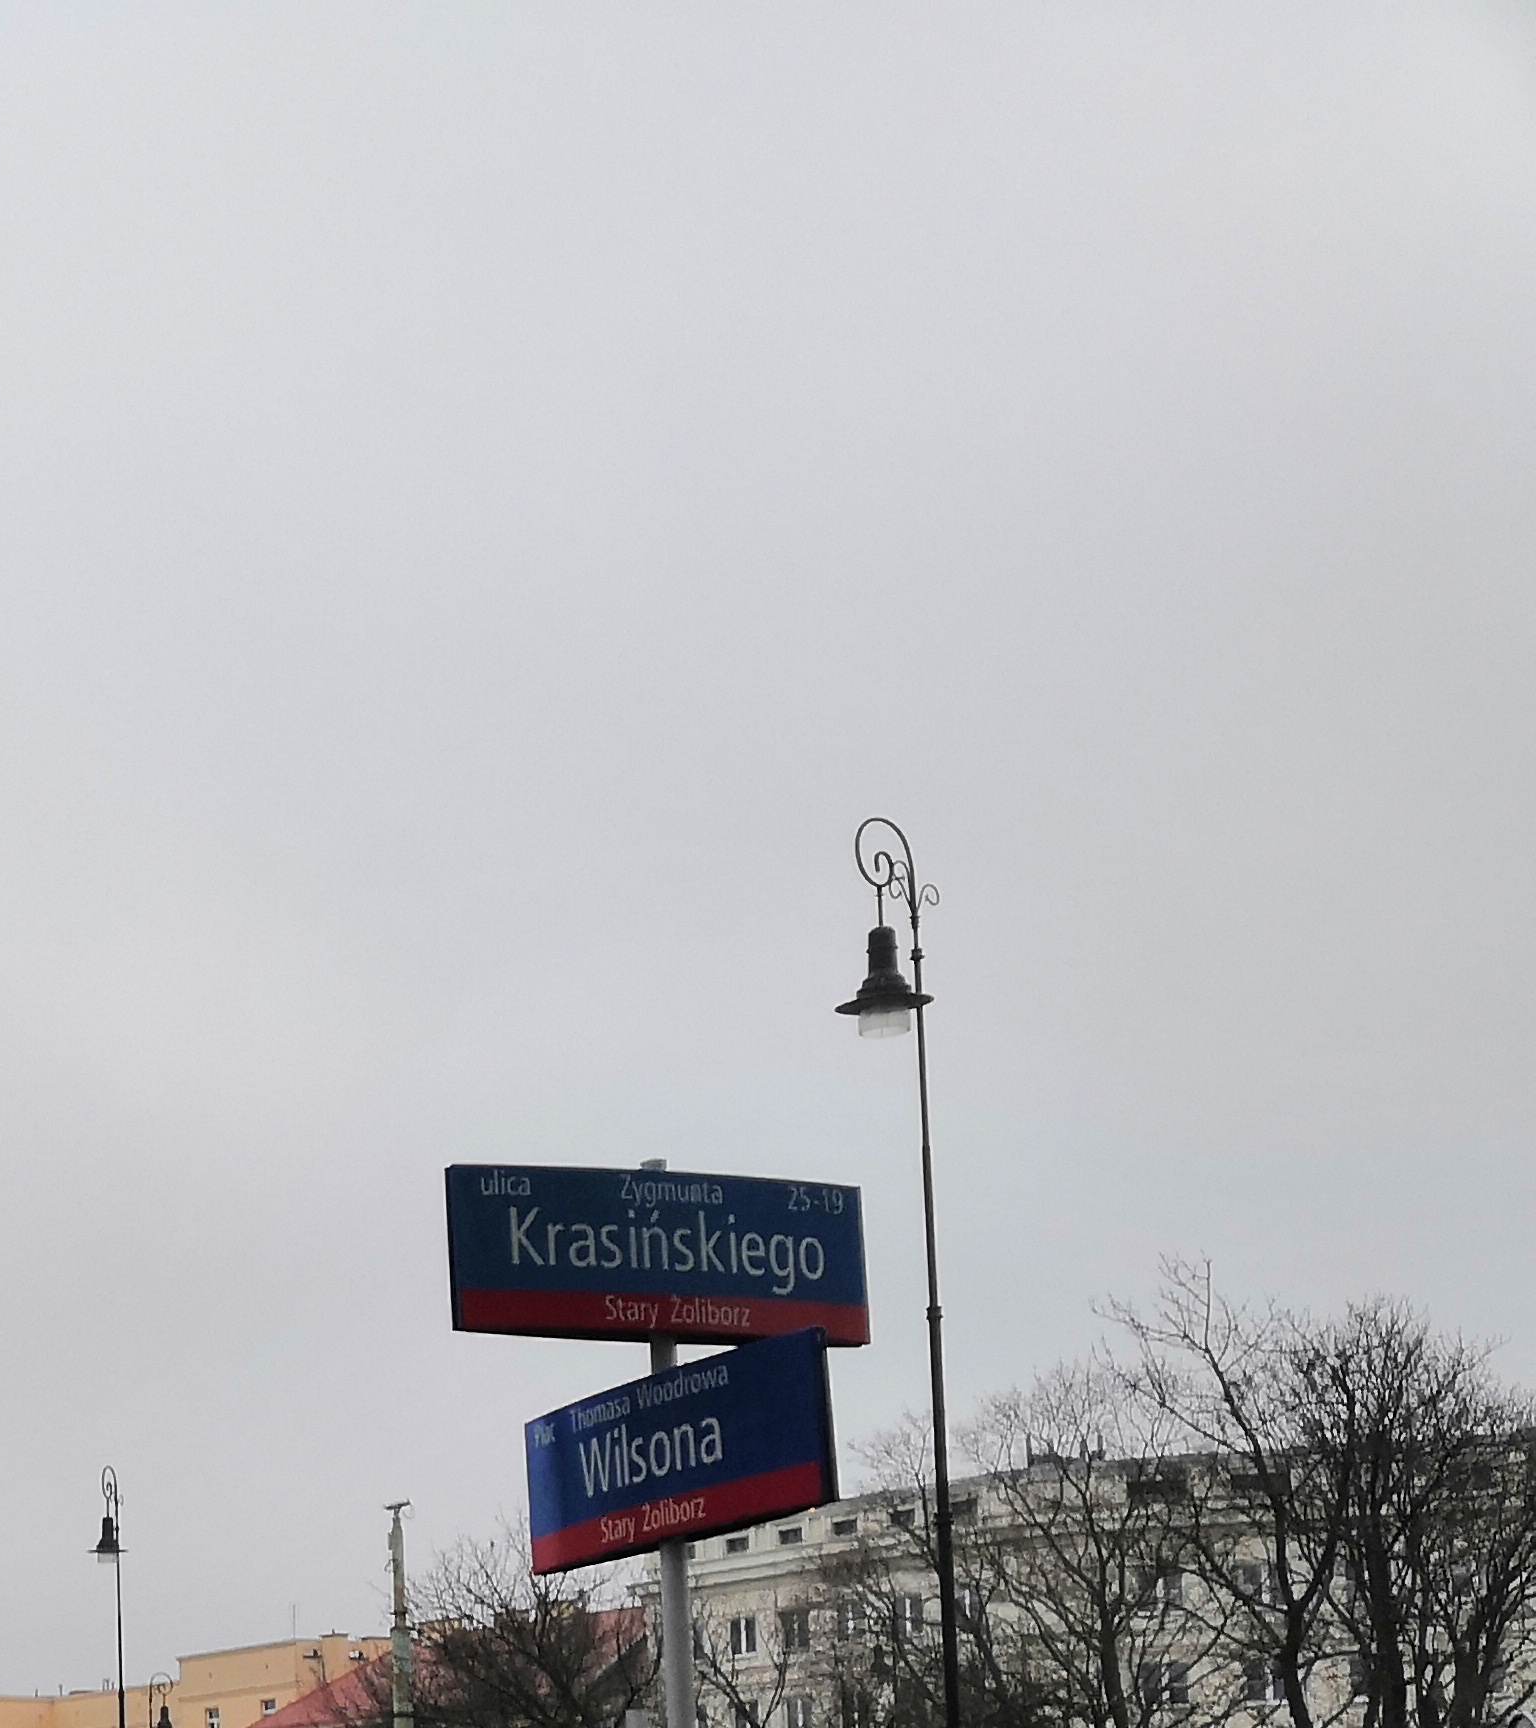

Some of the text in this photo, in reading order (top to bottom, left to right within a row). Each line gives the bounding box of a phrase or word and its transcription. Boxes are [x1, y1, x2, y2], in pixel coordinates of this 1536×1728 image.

[480, 1169, 844, 1215] ulica Zygmunta 25-19
[508, 1205, 826, 1296] Krasińskiego
[604, 1294, 659, 1329] Stary
[569, 1395, 632, 1434] Thomasa
[636, 1365, 729, 1410] Woodrowa
[578, 1416, 724, 1499] Wilsona
[600, 1516, 636, 1544] Stary
